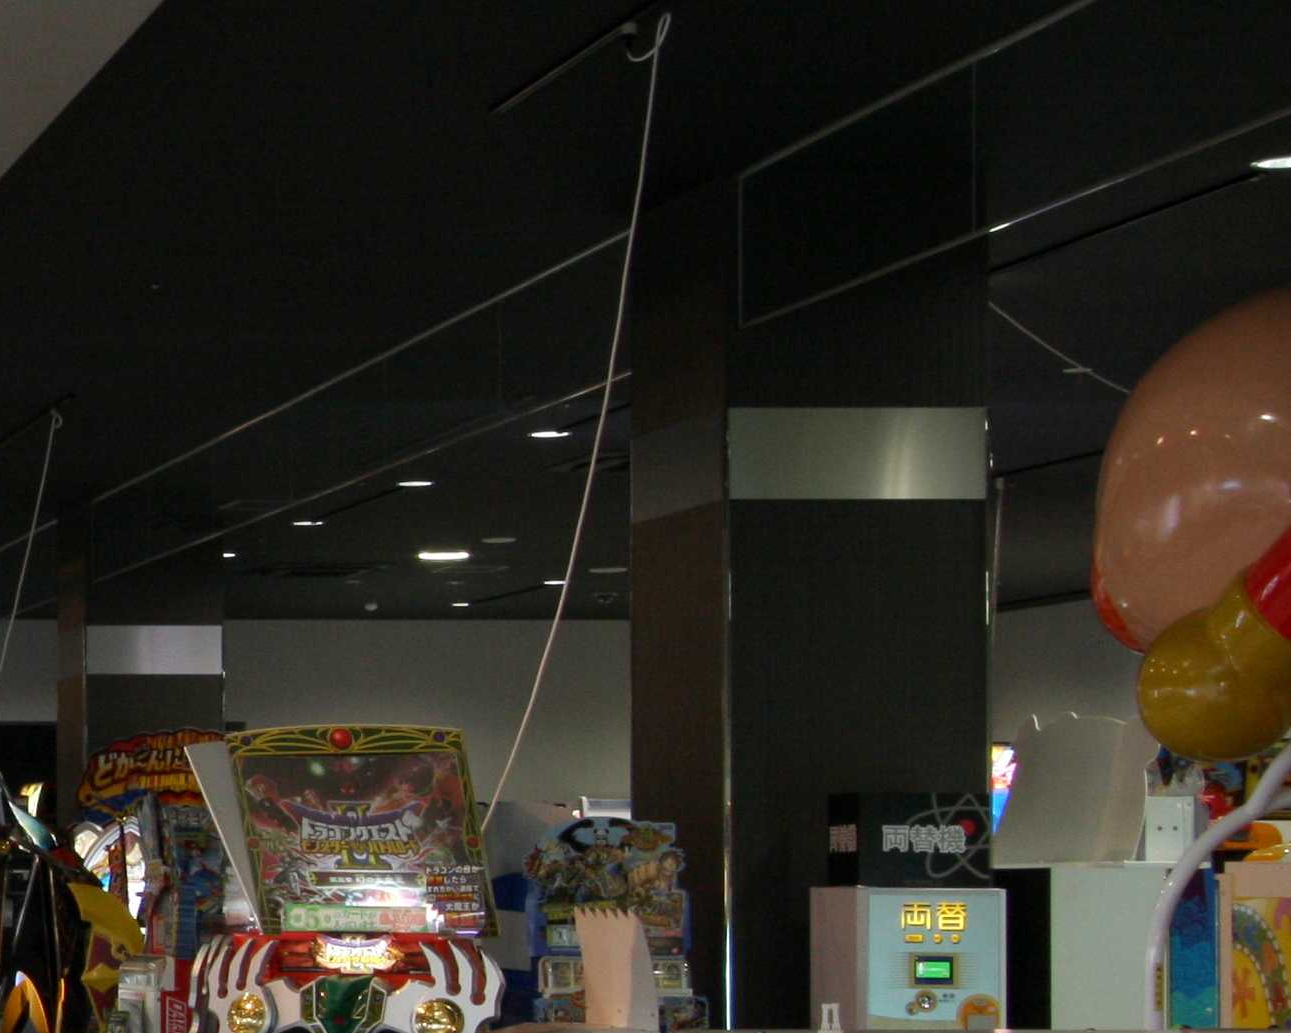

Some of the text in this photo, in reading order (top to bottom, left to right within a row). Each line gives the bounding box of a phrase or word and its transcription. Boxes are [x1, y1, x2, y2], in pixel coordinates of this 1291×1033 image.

[882, 824, 966, 854] 両替機
[901, 902, 968, 931] 両替
